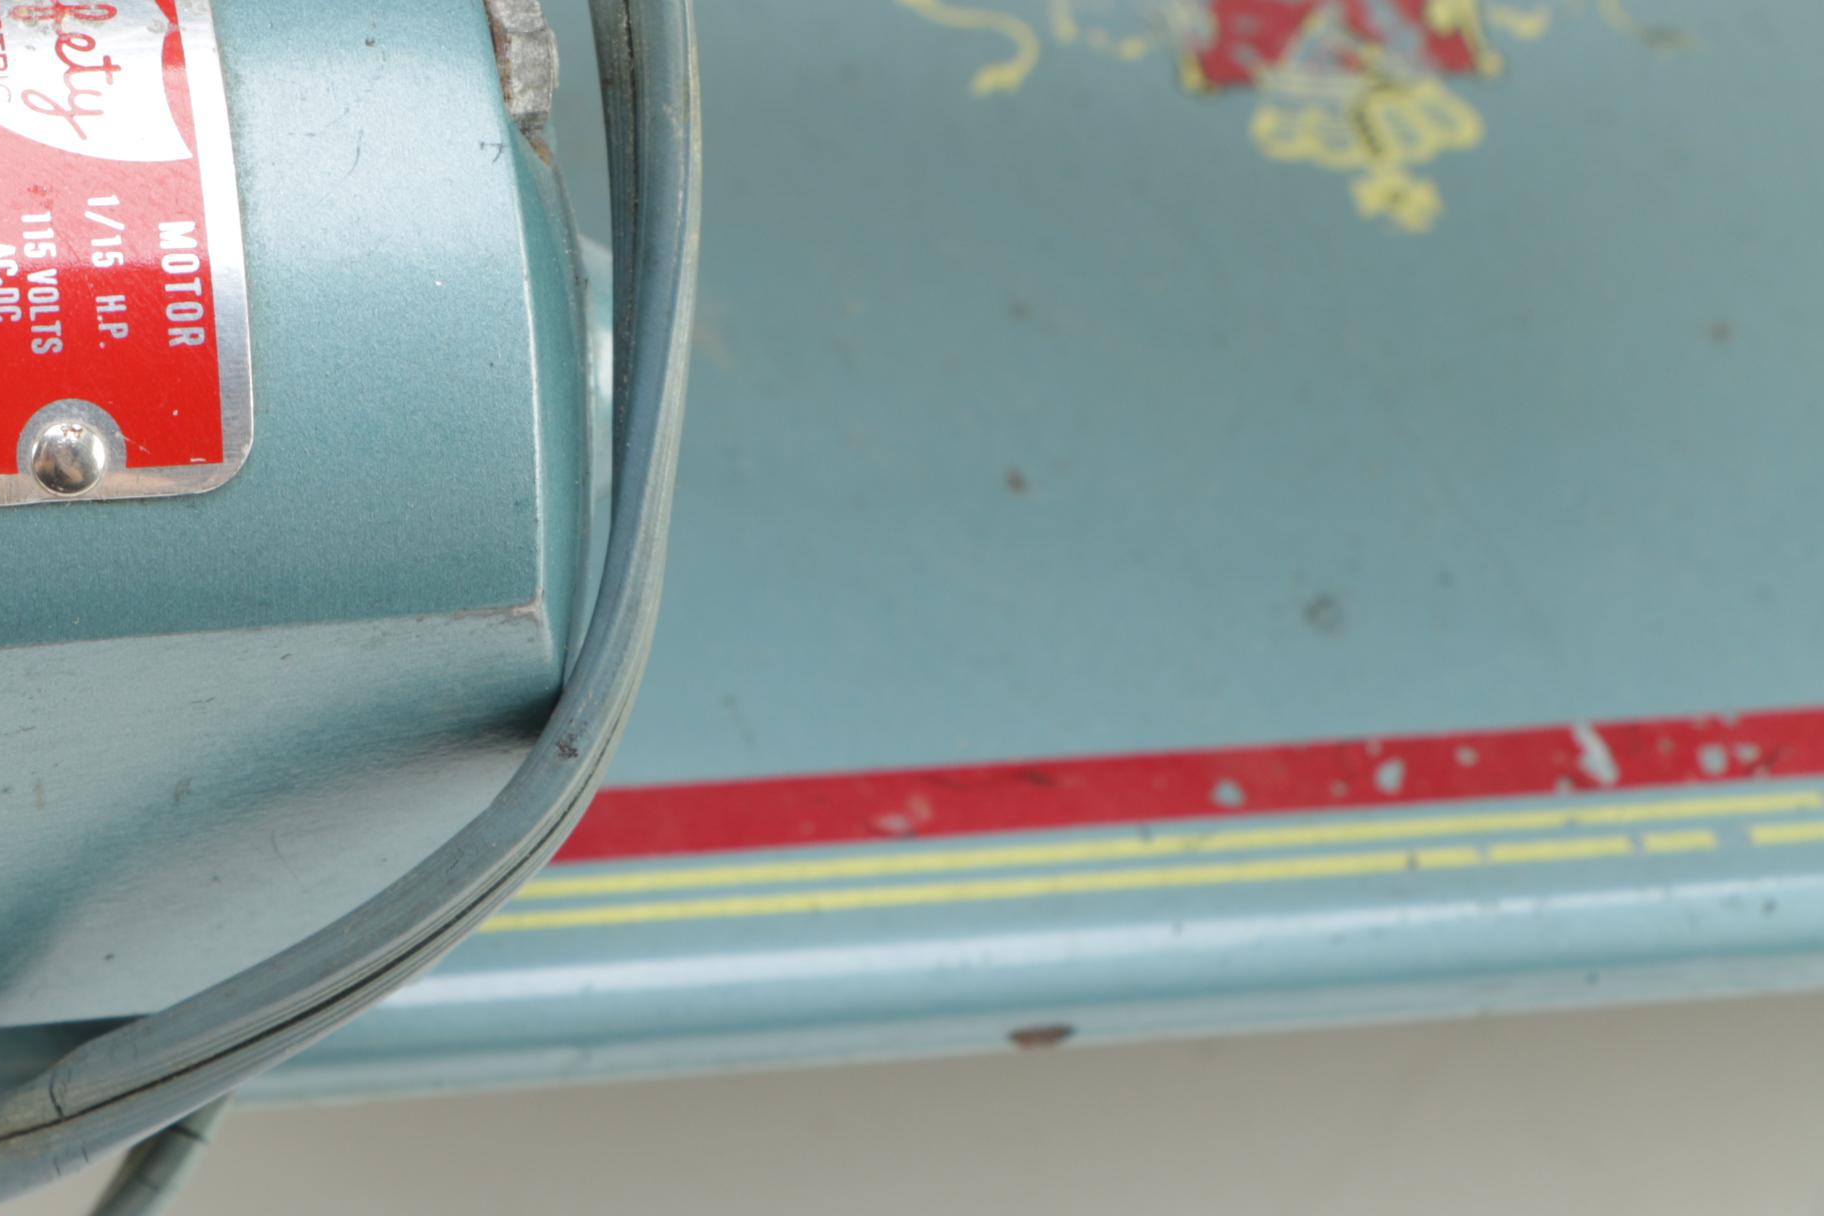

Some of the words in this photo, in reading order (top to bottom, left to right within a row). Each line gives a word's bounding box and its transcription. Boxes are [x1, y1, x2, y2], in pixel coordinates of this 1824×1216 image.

[21, 212, 55, 266] 115
[86, 194, 124, 269] 1/15
[25, 269, 64, 355] VOLTS
[95, 294, 129, 349] H.P.
[158, 220, 206, 348] MOTOR
